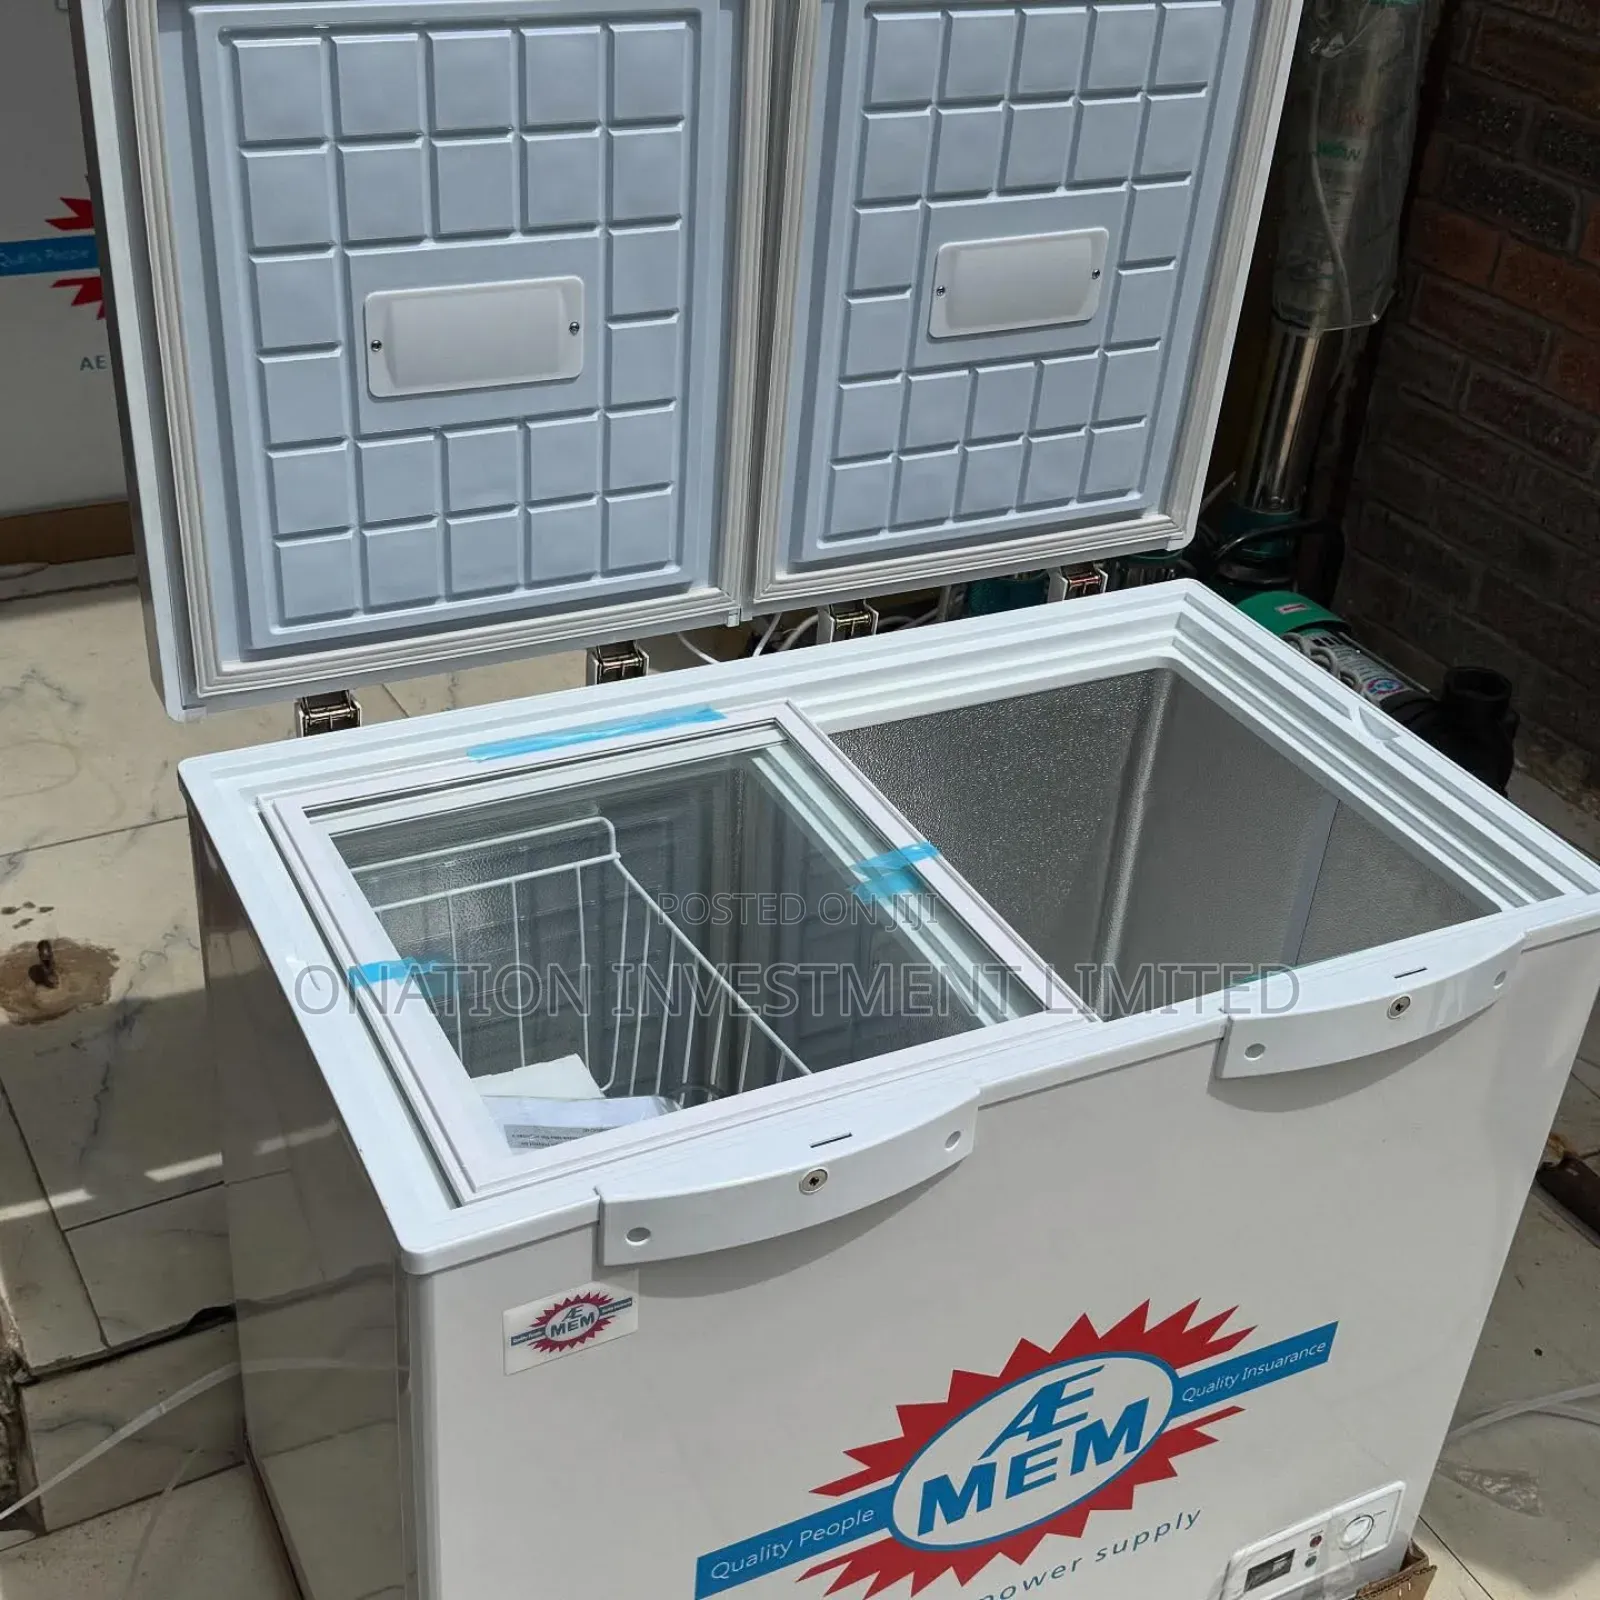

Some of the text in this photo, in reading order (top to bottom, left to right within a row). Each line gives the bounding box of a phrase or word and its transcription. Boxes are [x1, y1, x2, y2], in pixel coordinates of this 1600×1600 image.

[80, 355, 108, 371] AE
[550, 1312, 595, 1338] MEM
[1182, 1342, 1327, 1403] Quality Insuarance
[918, 1396, 1150, 1537] MEM
[710, 1508, 875, 1581] Quality People
[979, 1508, 1201, 1600] ower supply
